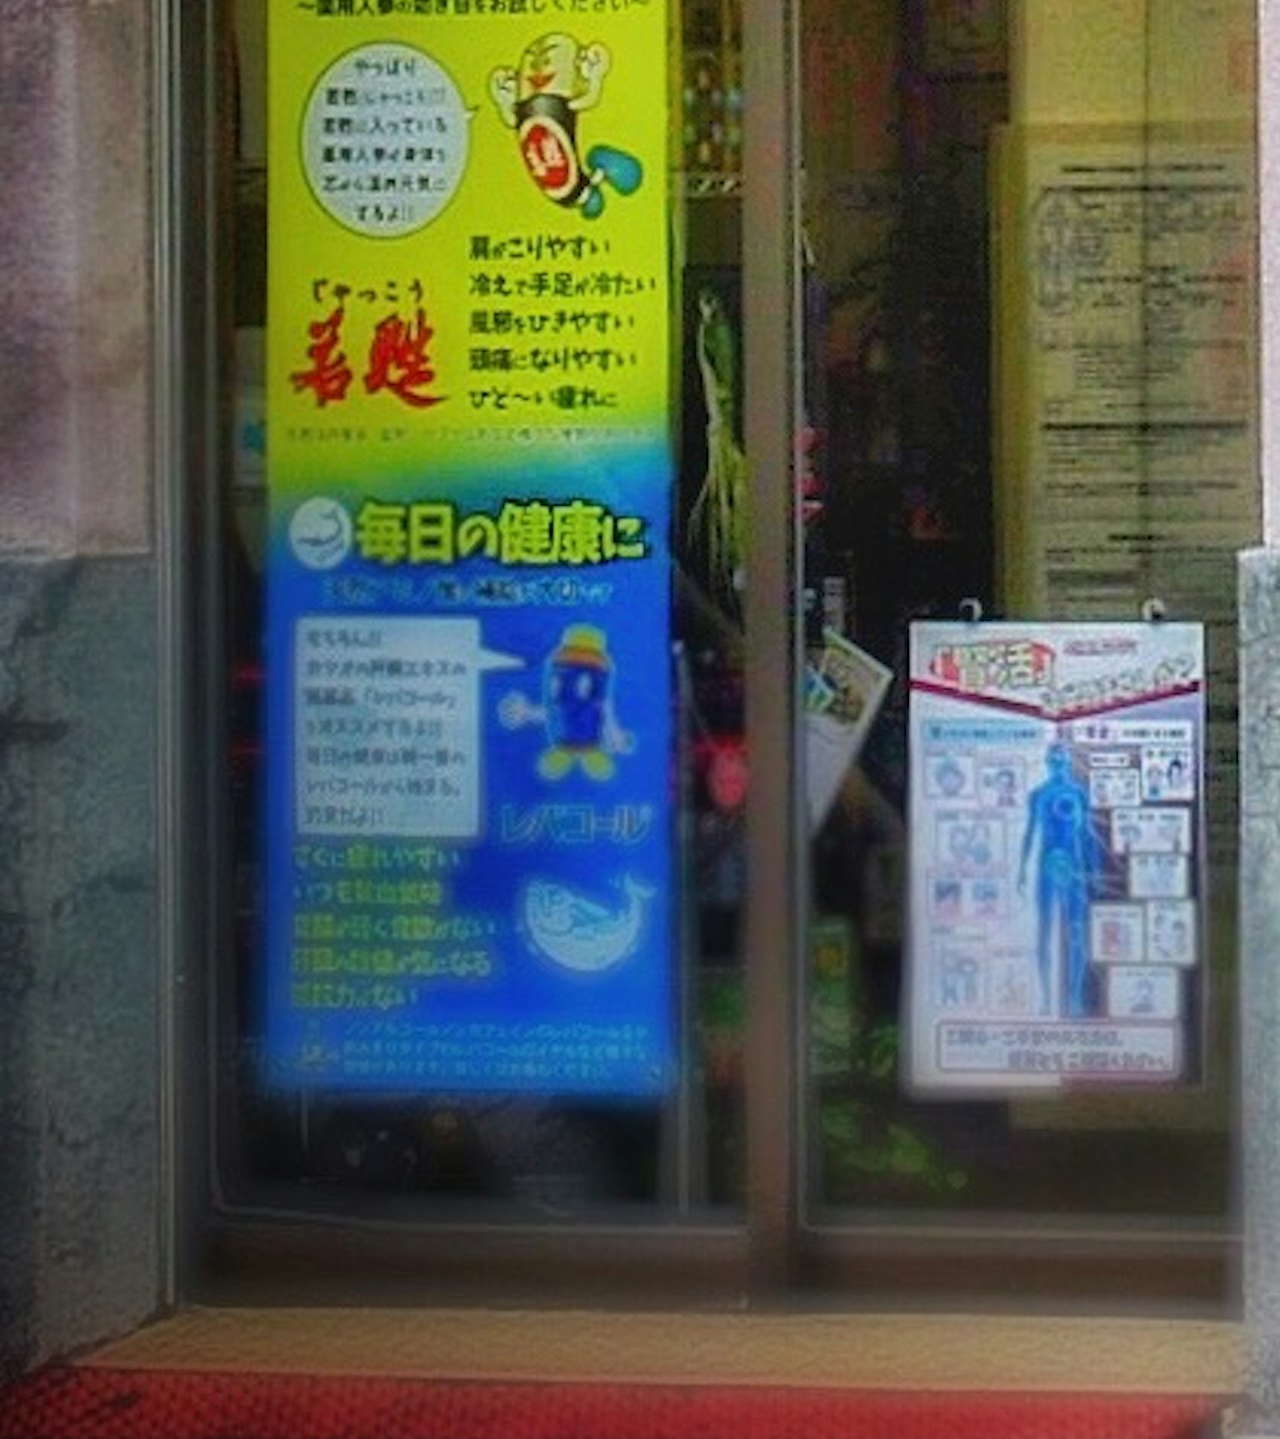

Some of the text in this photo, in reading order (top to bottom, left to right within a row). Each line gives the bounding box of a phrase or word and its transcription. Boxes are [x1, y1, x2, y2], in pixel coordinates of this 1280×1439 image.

[355, 500, 645, 566] 毎日の健康に
[501, 803, 654, 847] レバコール
